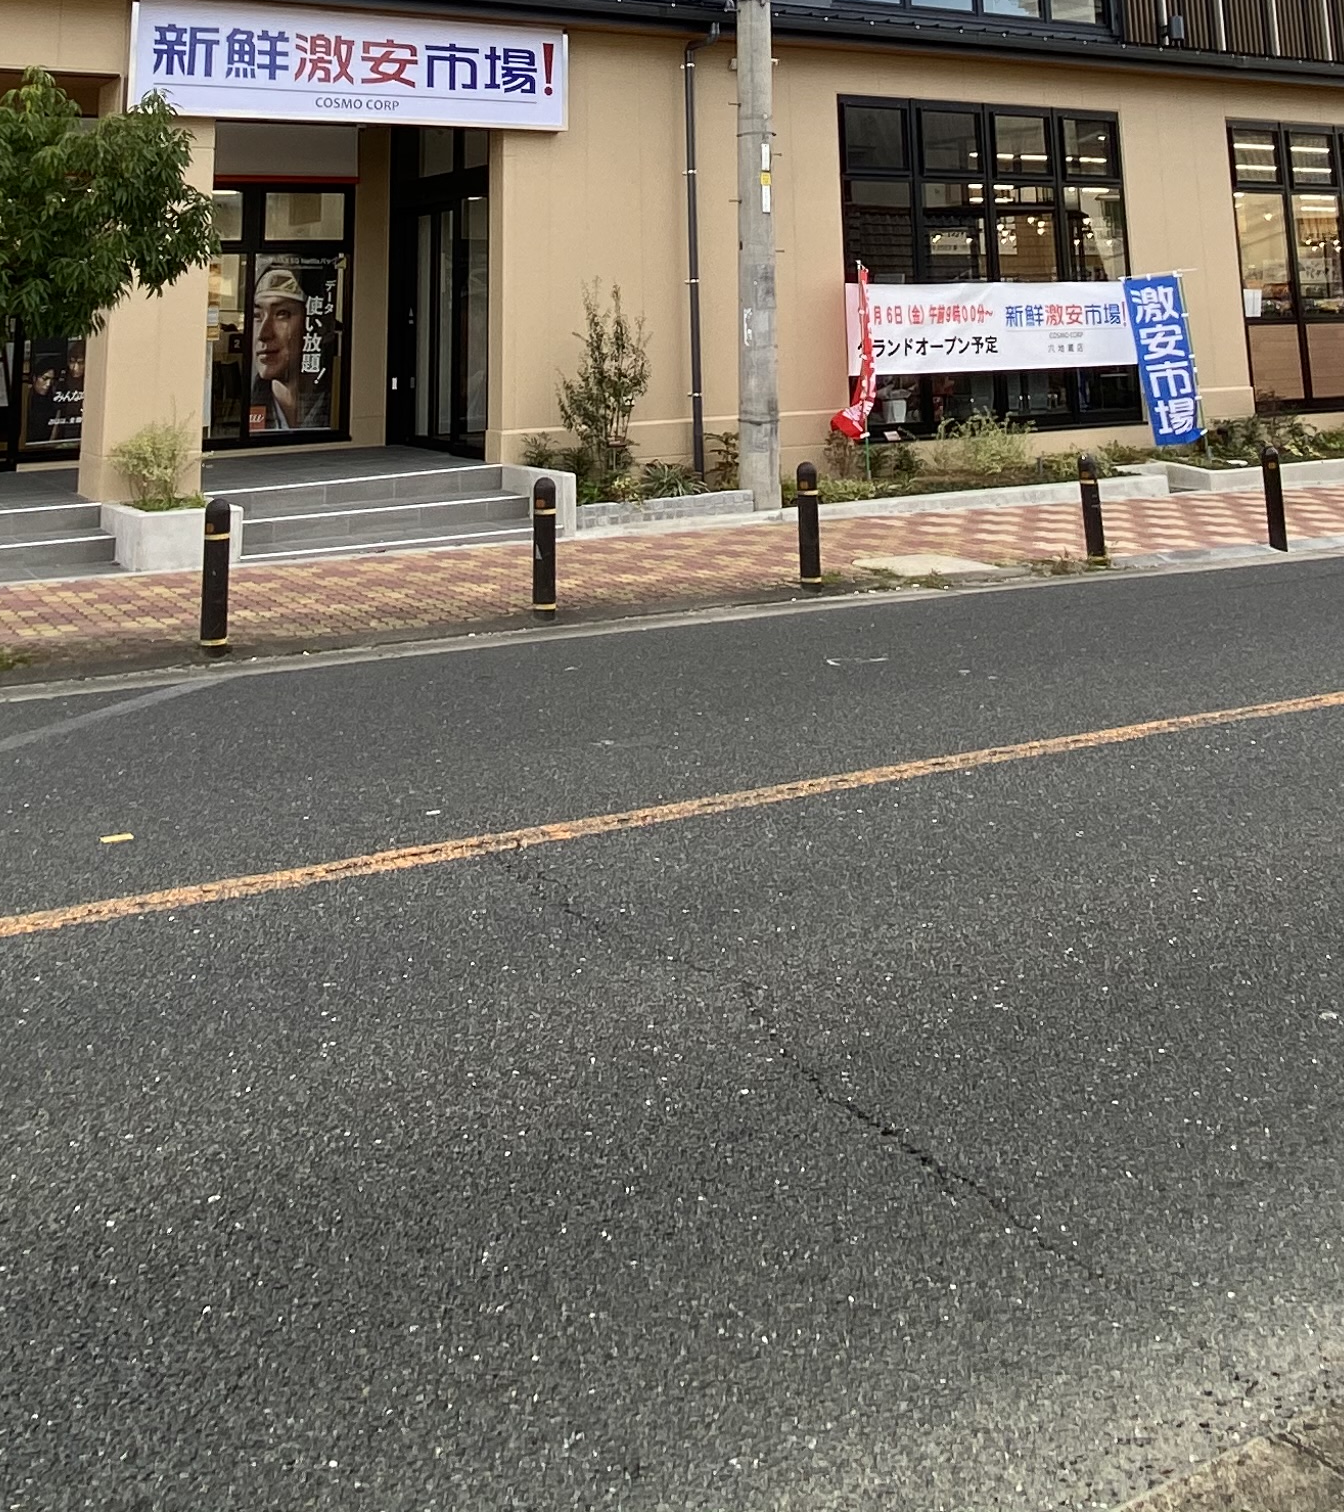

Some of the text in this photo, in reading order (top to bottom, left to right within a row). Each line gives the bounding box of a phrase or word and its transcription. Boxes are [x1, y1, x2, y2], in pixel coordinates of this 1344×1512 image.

[153, 23, 555, 96] 新鮮激安市場!
[315, 96, 400, 111] COSMO CORP
[323, 279, 337, 315] データ
[1129, 284, 1195, 436] 激安市場
